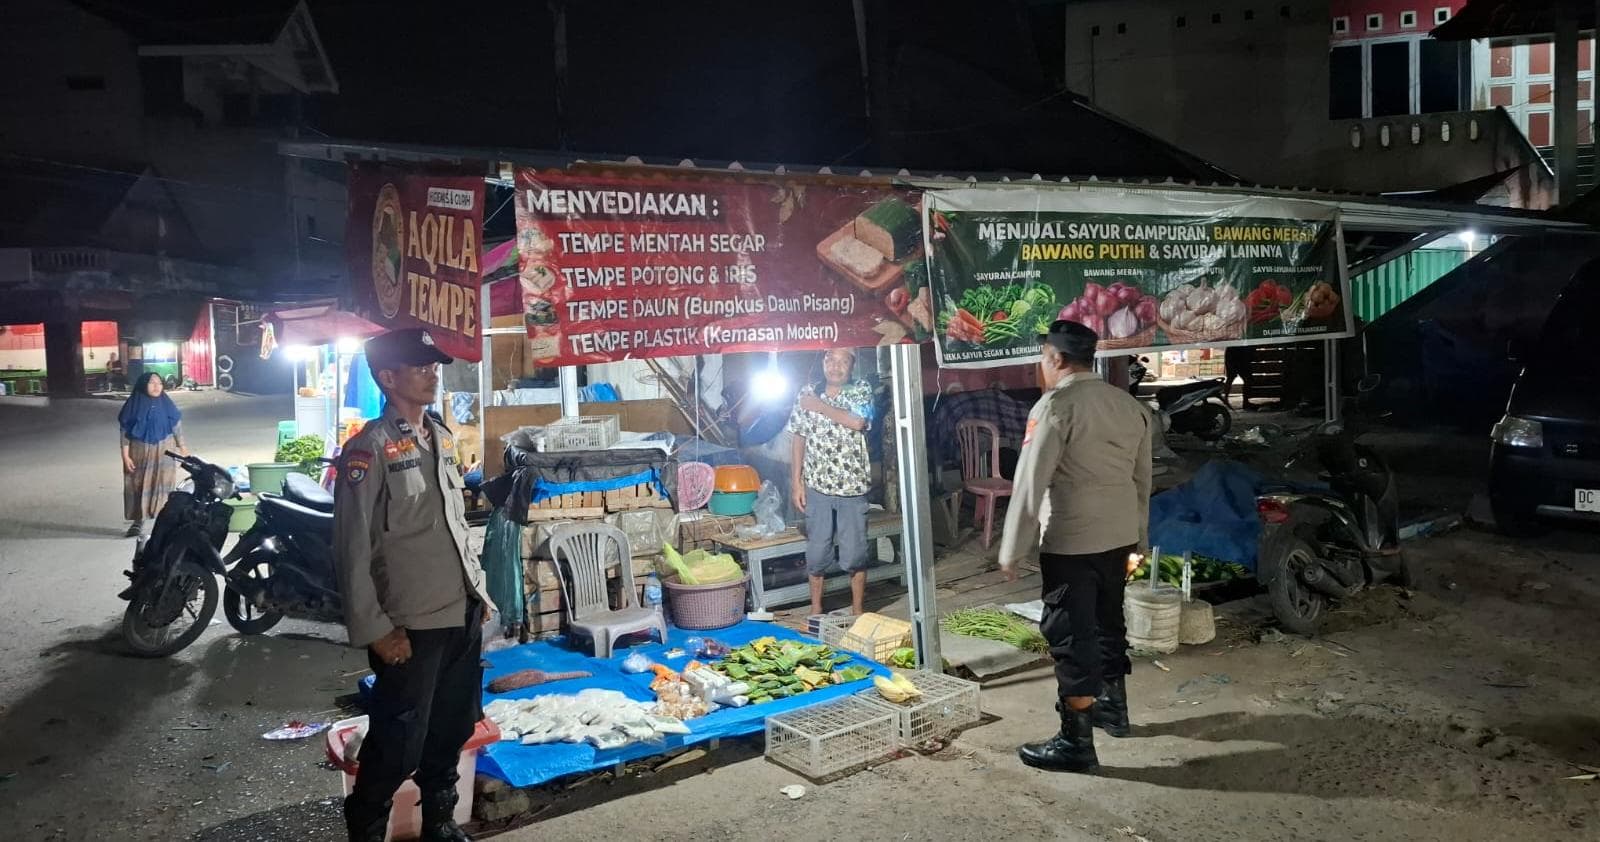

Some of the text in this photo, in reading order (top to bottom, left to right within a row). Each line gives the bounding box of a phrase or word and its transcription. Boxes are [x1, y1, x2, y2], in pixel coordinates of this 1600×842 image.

[526, 189, 706, 217] MENYEDIAKAN
[407, 211, 478, 275] AQILA
[558, 232, 766, 254] TEMPE MENTAH SEGAR
[978, 222, 1066, 240] MENJUAL
[1068, 223, 1121, 240] SAYUR
[1124, 224, 1211, 243] CAMPURAN,
[1213, 226, 1272, 241] BAWANG
[1021, 243, 1283, 261] BAWANG PUTIH & SAYURAN LAINNYA
[561, 265, 758, 289] TEMPE POTONG & IRIS
[406, 271, 477, 338] TEMPE
[566, 292, 855, 322] TEMPE DAUN (Bungkus Daun Pisang)
[568, 322, 840, 355] TEMPE PLASTIK (Kemasan Modern)
[1011, 345, 1044, 356] BERKUALIT
[1579, 490, 1594, 504] DC
